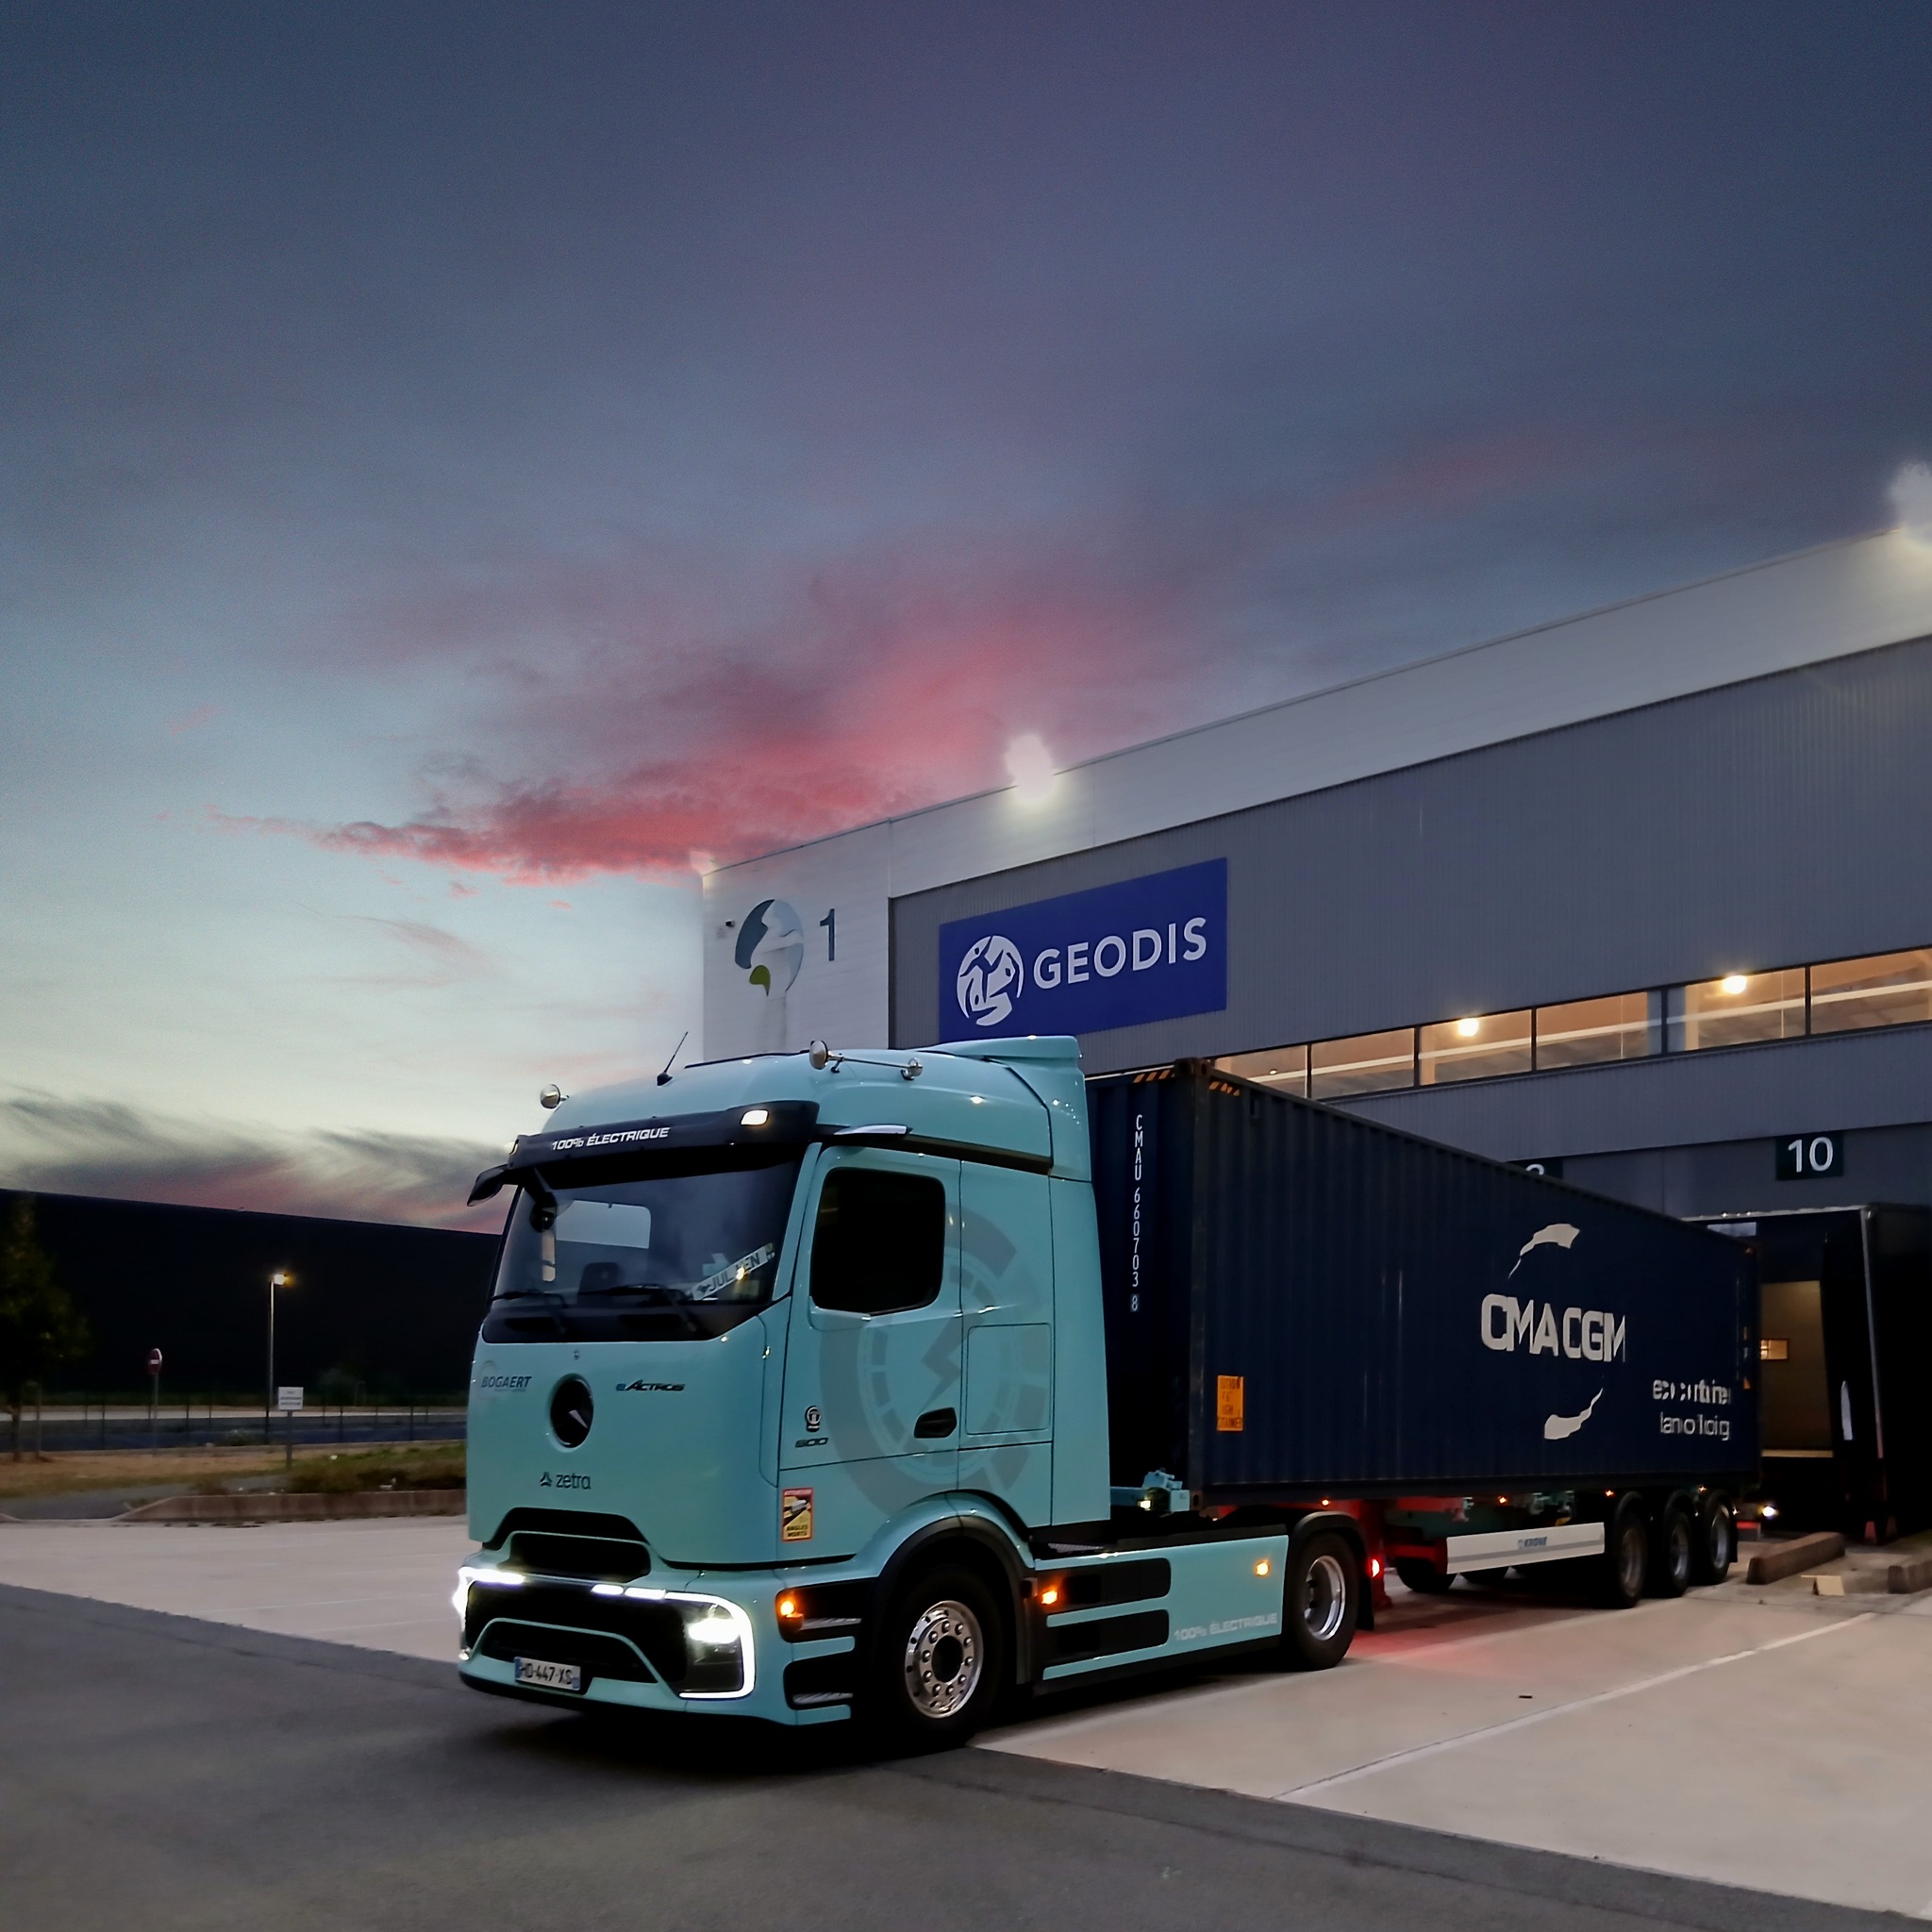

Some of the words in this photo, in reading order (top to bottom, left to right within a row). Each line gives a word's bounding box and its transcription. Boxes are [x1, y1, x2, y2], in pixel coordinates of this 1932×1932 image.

[820, 908, 835, 961] 1
[1034, 917, 1208, 990] GEODIS
[552, 1138, 585, 1150] 100%
[586, 1127, 670, 1146] ÉLECTRIQUE
[1135, 1114, 1143, 1180] CMAU
[1788, 1137, 1834, 1173] 10
[1132, 1187, 1141, 1287] 660703
[708, 1252, 760, 1291] JULEN
[1131, 1294, 1139, 1311] 8
[1481, 1293, 1559, 1357] CMA
[1562, 1307, 1626, 1363] CGM
[481, 1375, 532, 1389] BOGAERT
[556, 1472, 591, 1490] zetra
[1174, 1625, 1208, 1641] 100%
